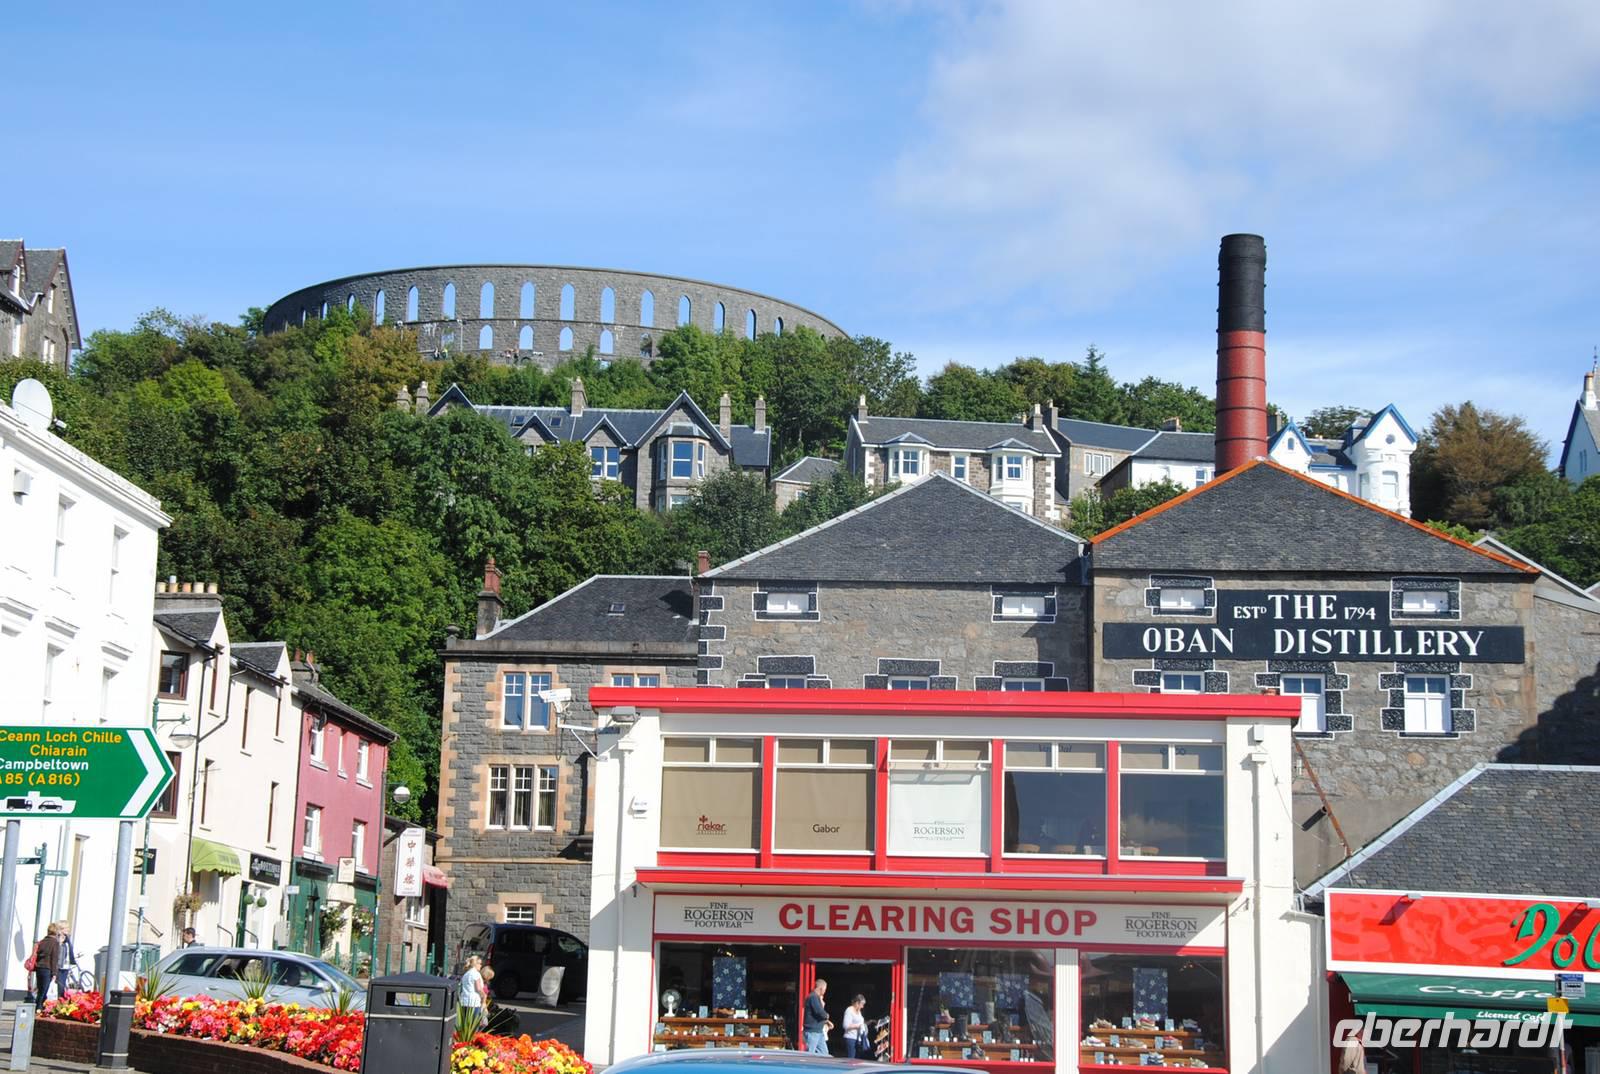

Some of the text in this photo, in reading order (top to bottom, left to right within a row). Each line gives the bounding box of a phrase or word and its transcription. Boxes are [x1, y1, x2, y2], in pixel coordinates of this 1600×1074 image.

[1267, 594, 1337, 620] THE
[1344, 606, 1376, 620] 1794
[1142, 627, 1484, 656] OBAN DISTILLERY
[0, 730, 122, 743] Ceann Loch Chille
[30, 744, 87, 756] Chiarain
[0, 758, 89, 771] Campbeltown
[812, 823, 841, 833] Gabor
[913, 826, 965, 836] ROGERSON
[709, 902, 729, 910] FINE
[684, 909, 754, 921] ROGERSON
[778, 903, 1097, 936] CLEARING SHOP
[1151, 911, 1171, 919] FINE
[694, 920, 742, 928] FOOTWEAR
[1125, 919, 1198, 930] ROGERSON
[1136, 930, 1187, 938] FOOTWEAR
[1476, 1011, 1521, 1021] Licensed
